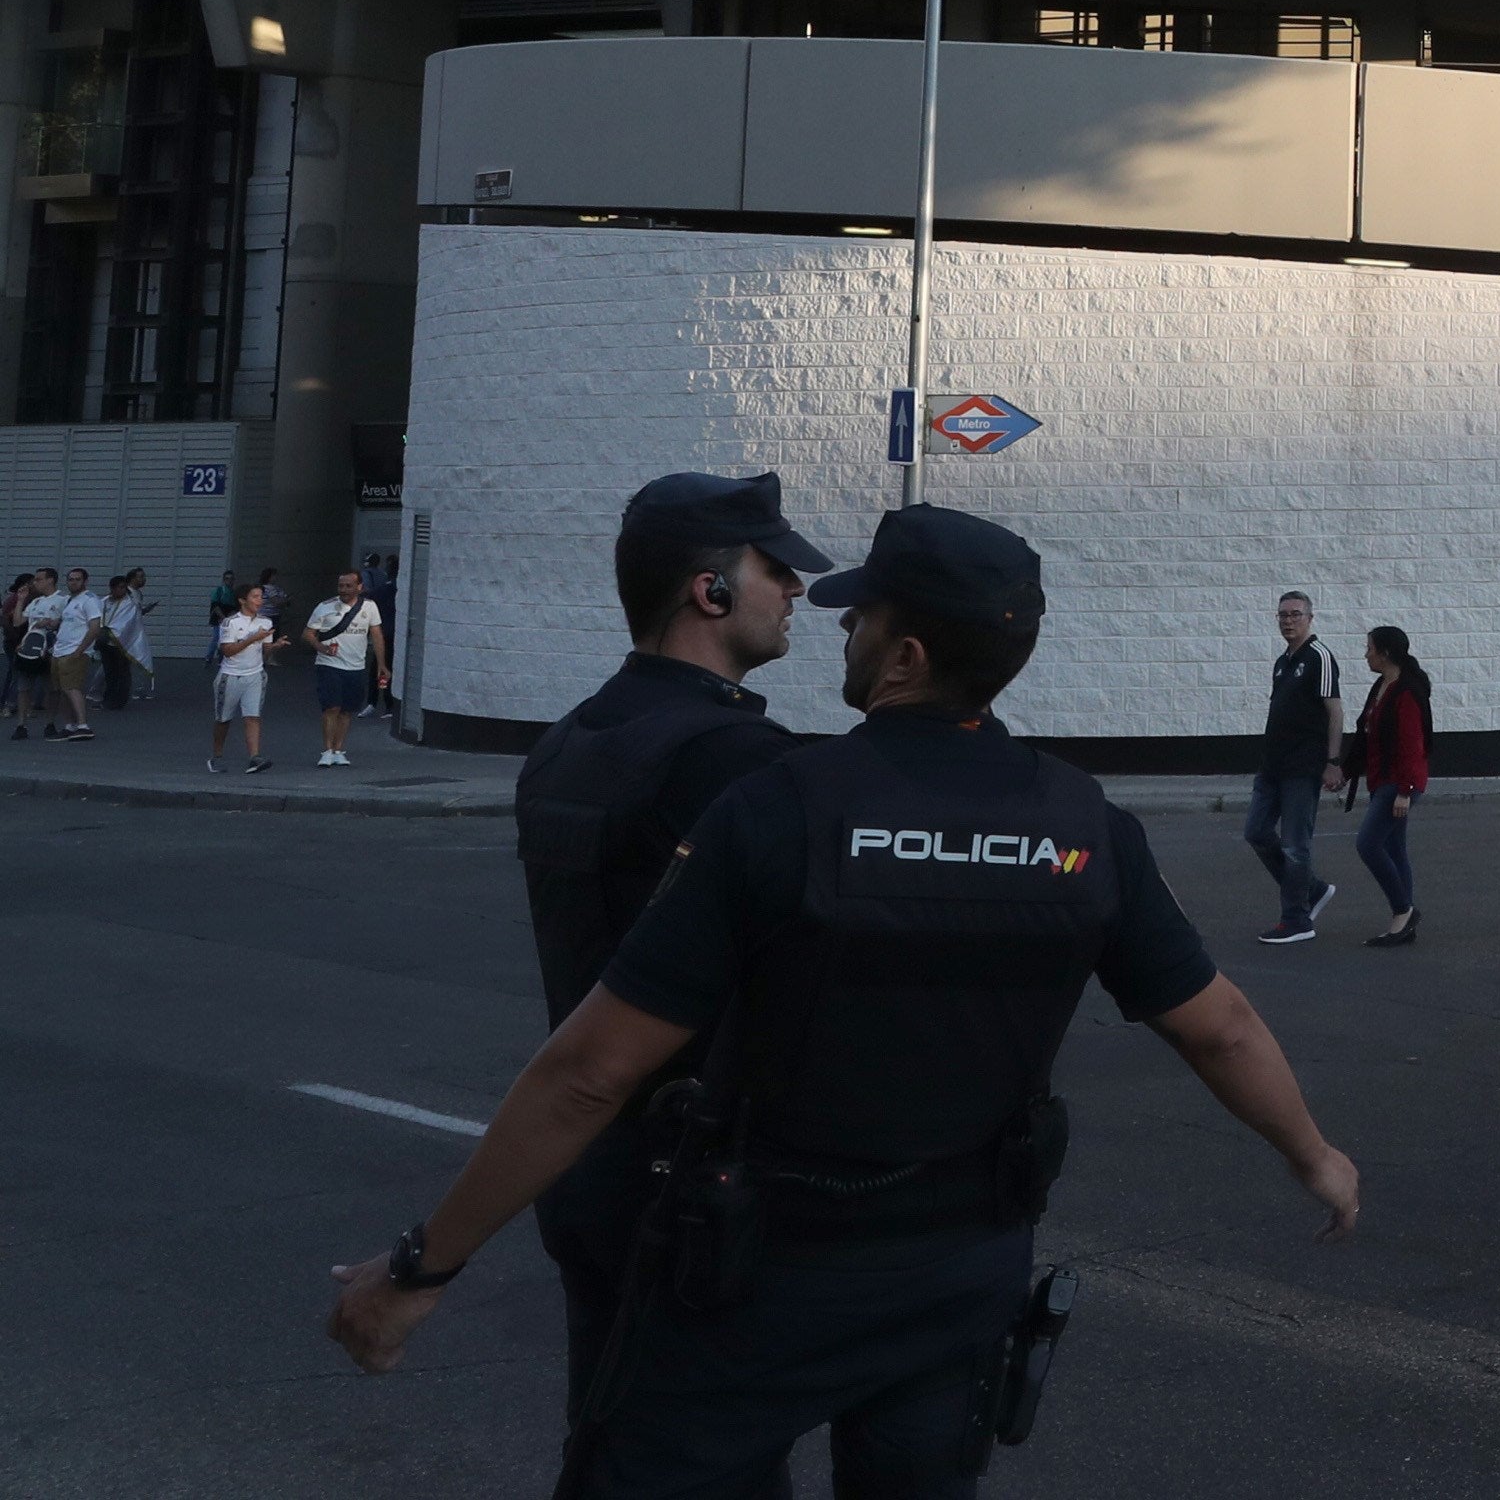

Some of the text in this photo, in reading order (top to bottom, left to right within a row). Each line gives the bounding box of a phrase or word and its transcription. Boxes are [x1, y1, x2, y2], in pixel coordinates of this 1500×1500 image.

[958, 419, 990, 429] Metro
[192, 468, 216, 492] 23
[361, 481, 388, 496] Área
[850, 828, 1062, 866] POLICIA
